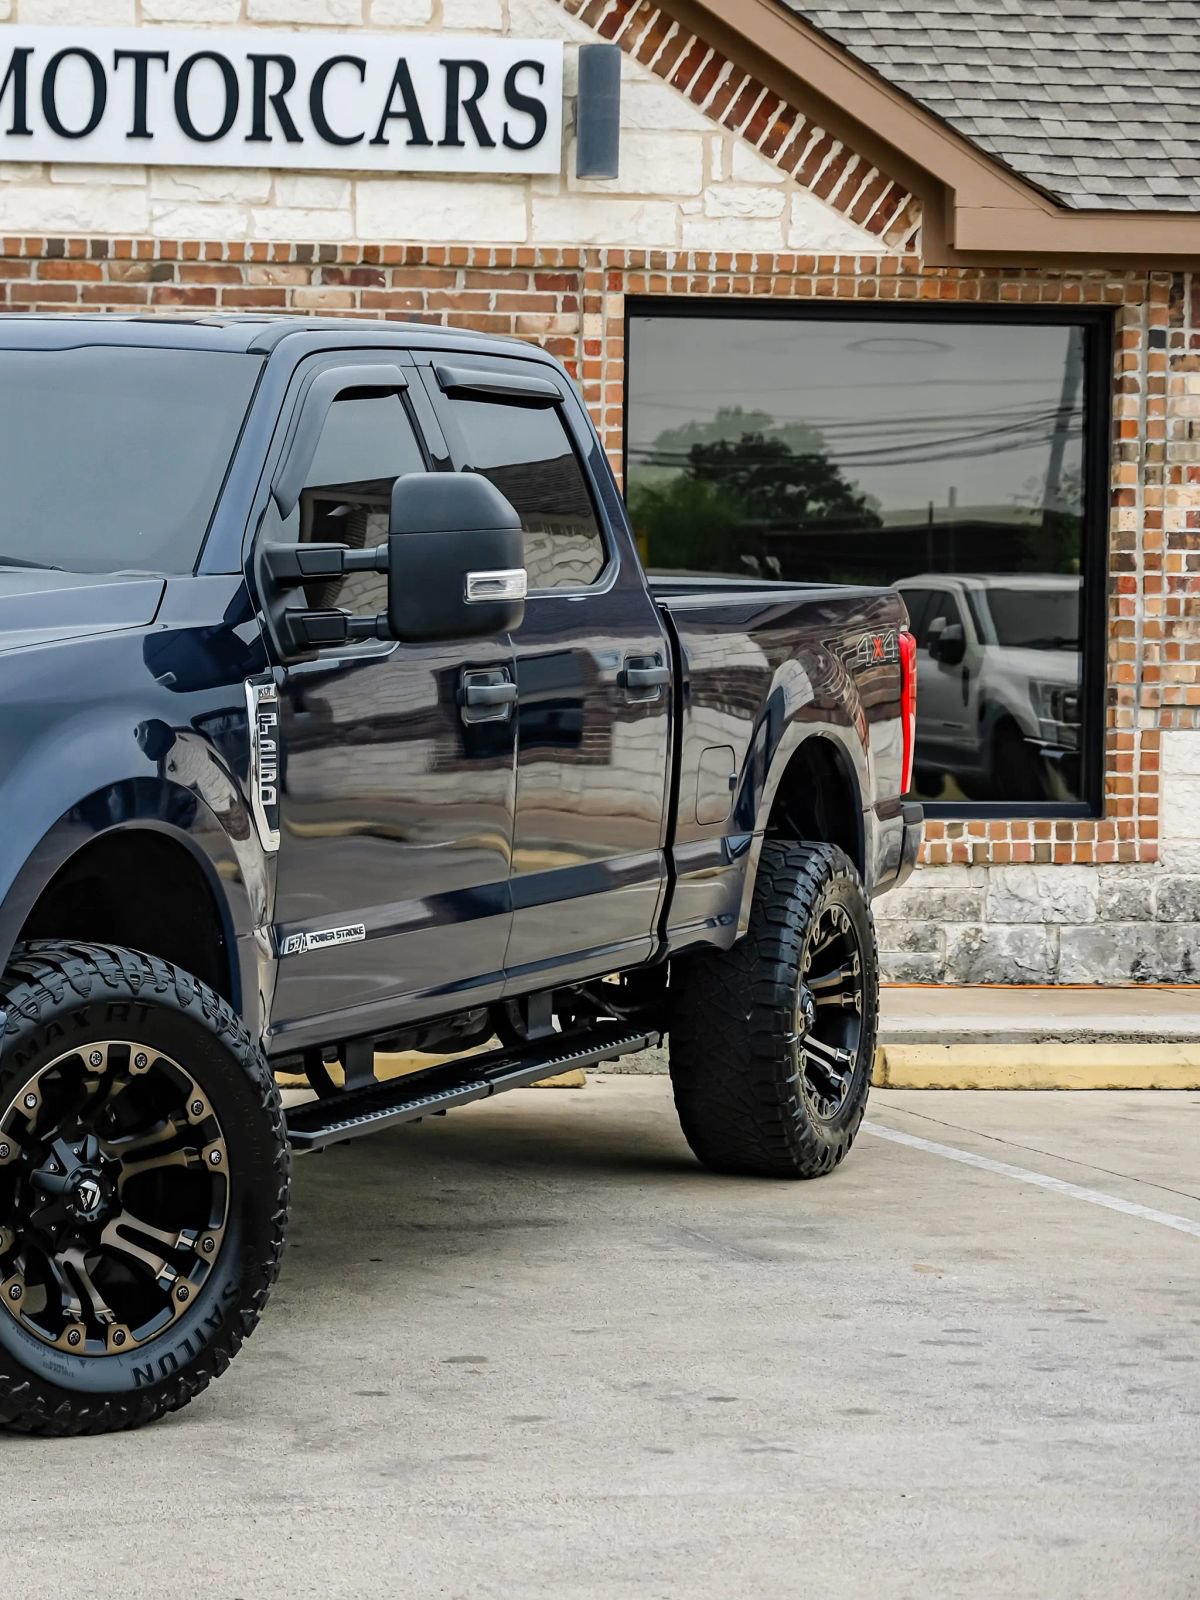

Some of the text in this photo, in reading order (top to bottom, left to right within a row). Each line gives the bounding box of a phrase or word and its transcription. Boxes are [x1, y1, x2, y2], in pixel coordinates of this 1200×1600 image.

[309, 931, 335, 945] POWER
[335, 925, 365, 940] STROKE
[131, 1279, 241, 1388] SAILUN
